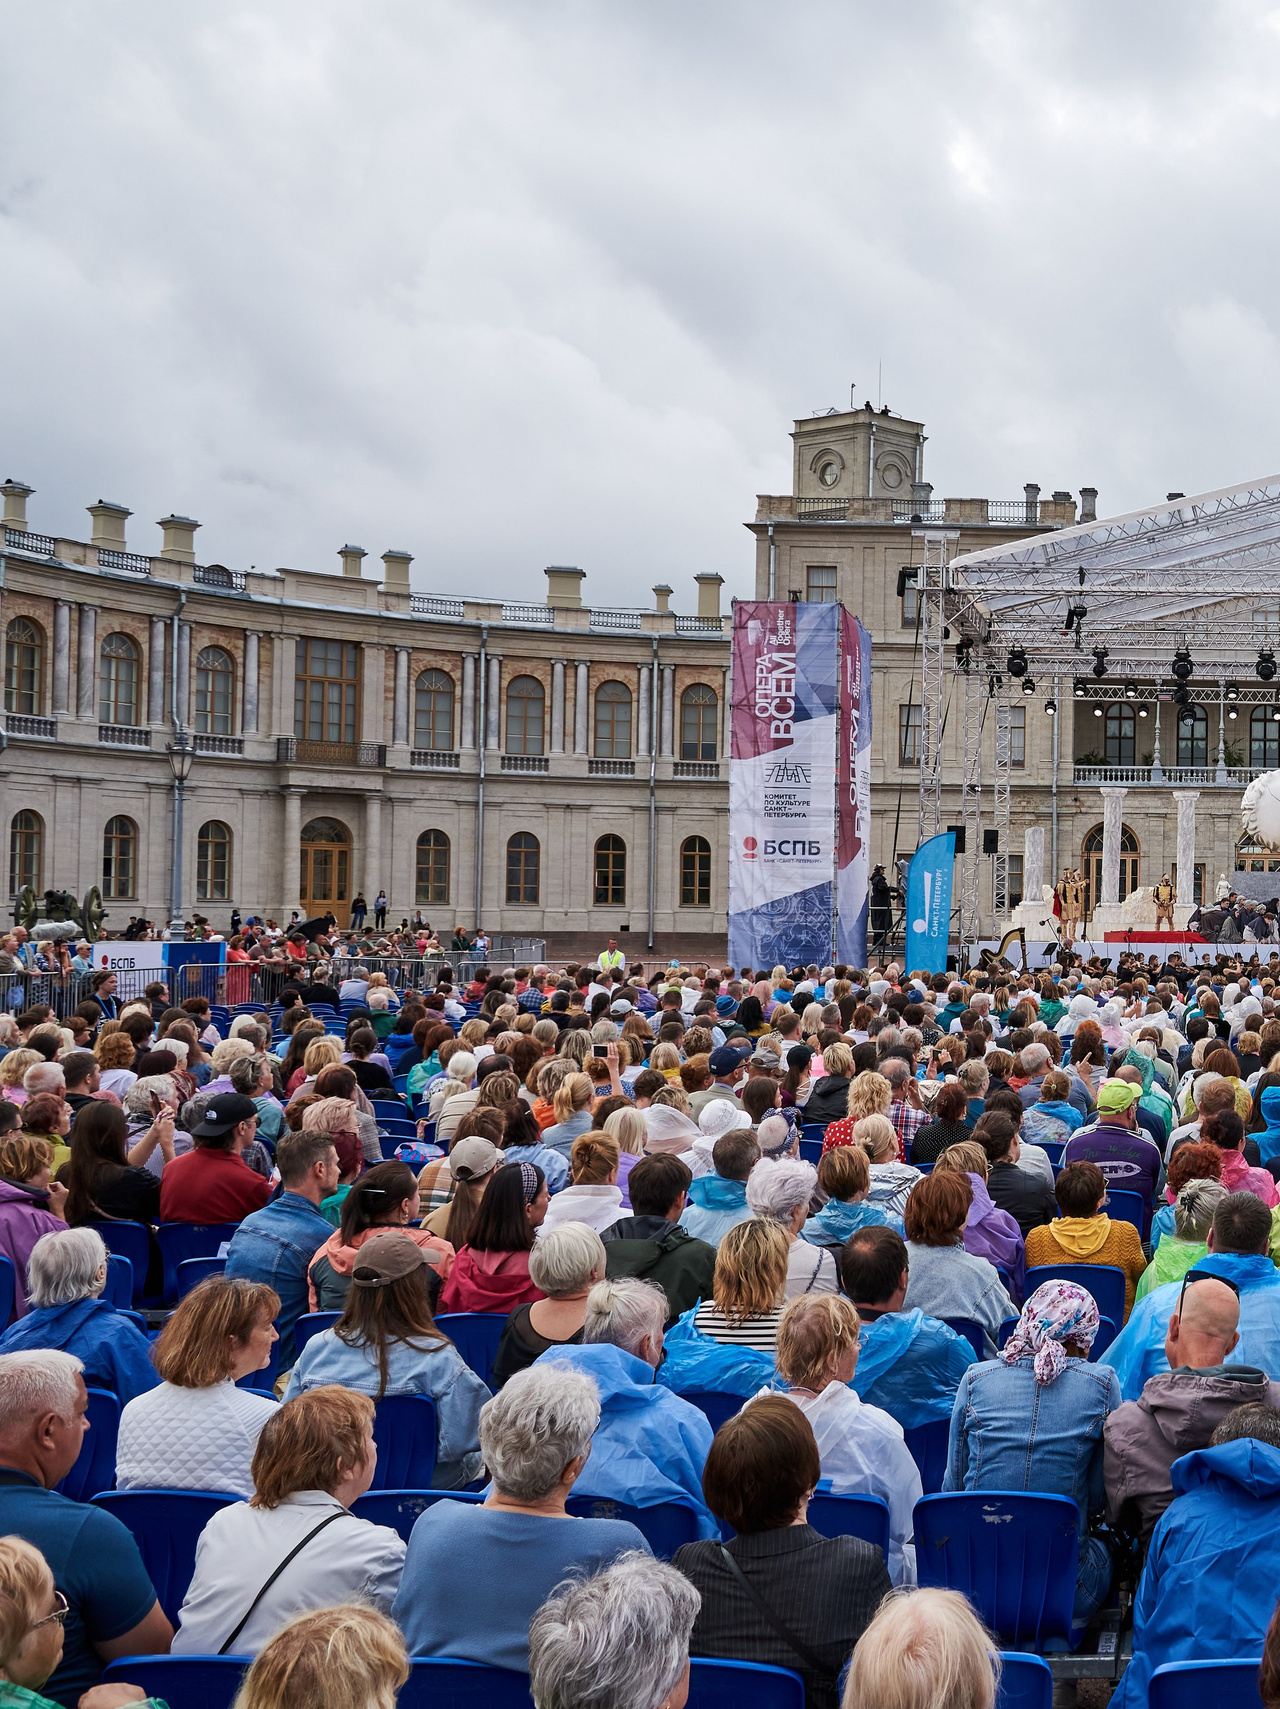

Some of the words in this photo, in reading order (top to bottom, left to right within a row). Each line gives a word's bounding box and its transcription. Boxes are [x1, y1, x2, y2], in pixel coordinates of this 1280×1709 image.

[770, 636, 778, 645] All
[783, 620, 791, 645] Opera
[770, 653, 796, 738] ВСЕМ
[764, 840, 820, 856] БСПБ
[111, 958, 135, 969] БСПБ
